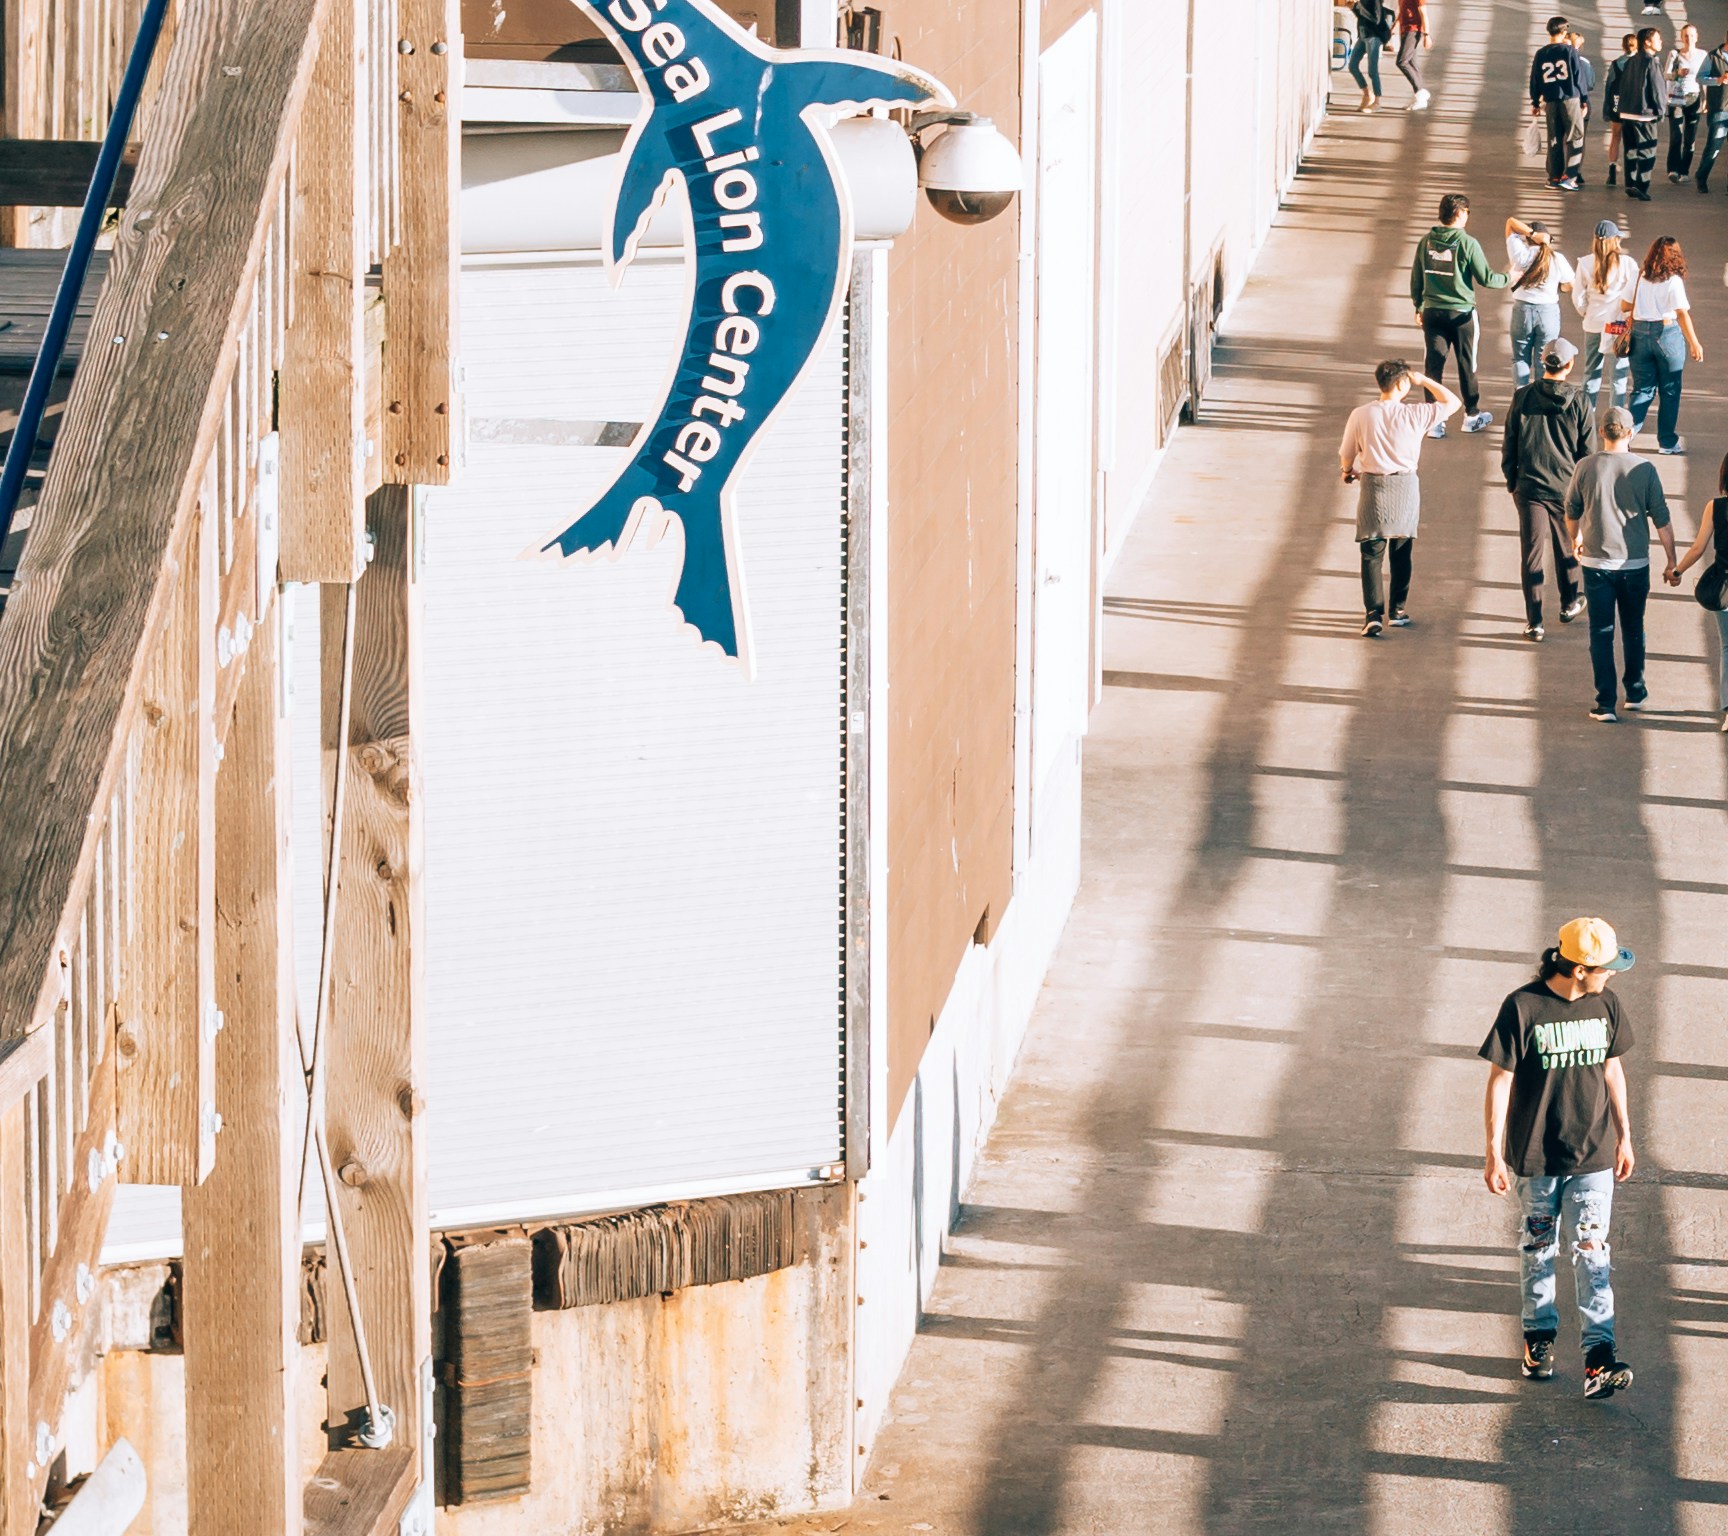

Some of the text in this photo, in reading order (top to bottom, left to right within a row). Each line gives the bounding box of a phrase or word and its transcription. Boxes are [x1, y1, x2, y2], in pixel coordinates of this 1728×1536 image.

[1541, 59, 1569, 84] 23
[690, 107, 765, 253] Lion
[662, 270, 775, 493] Center
